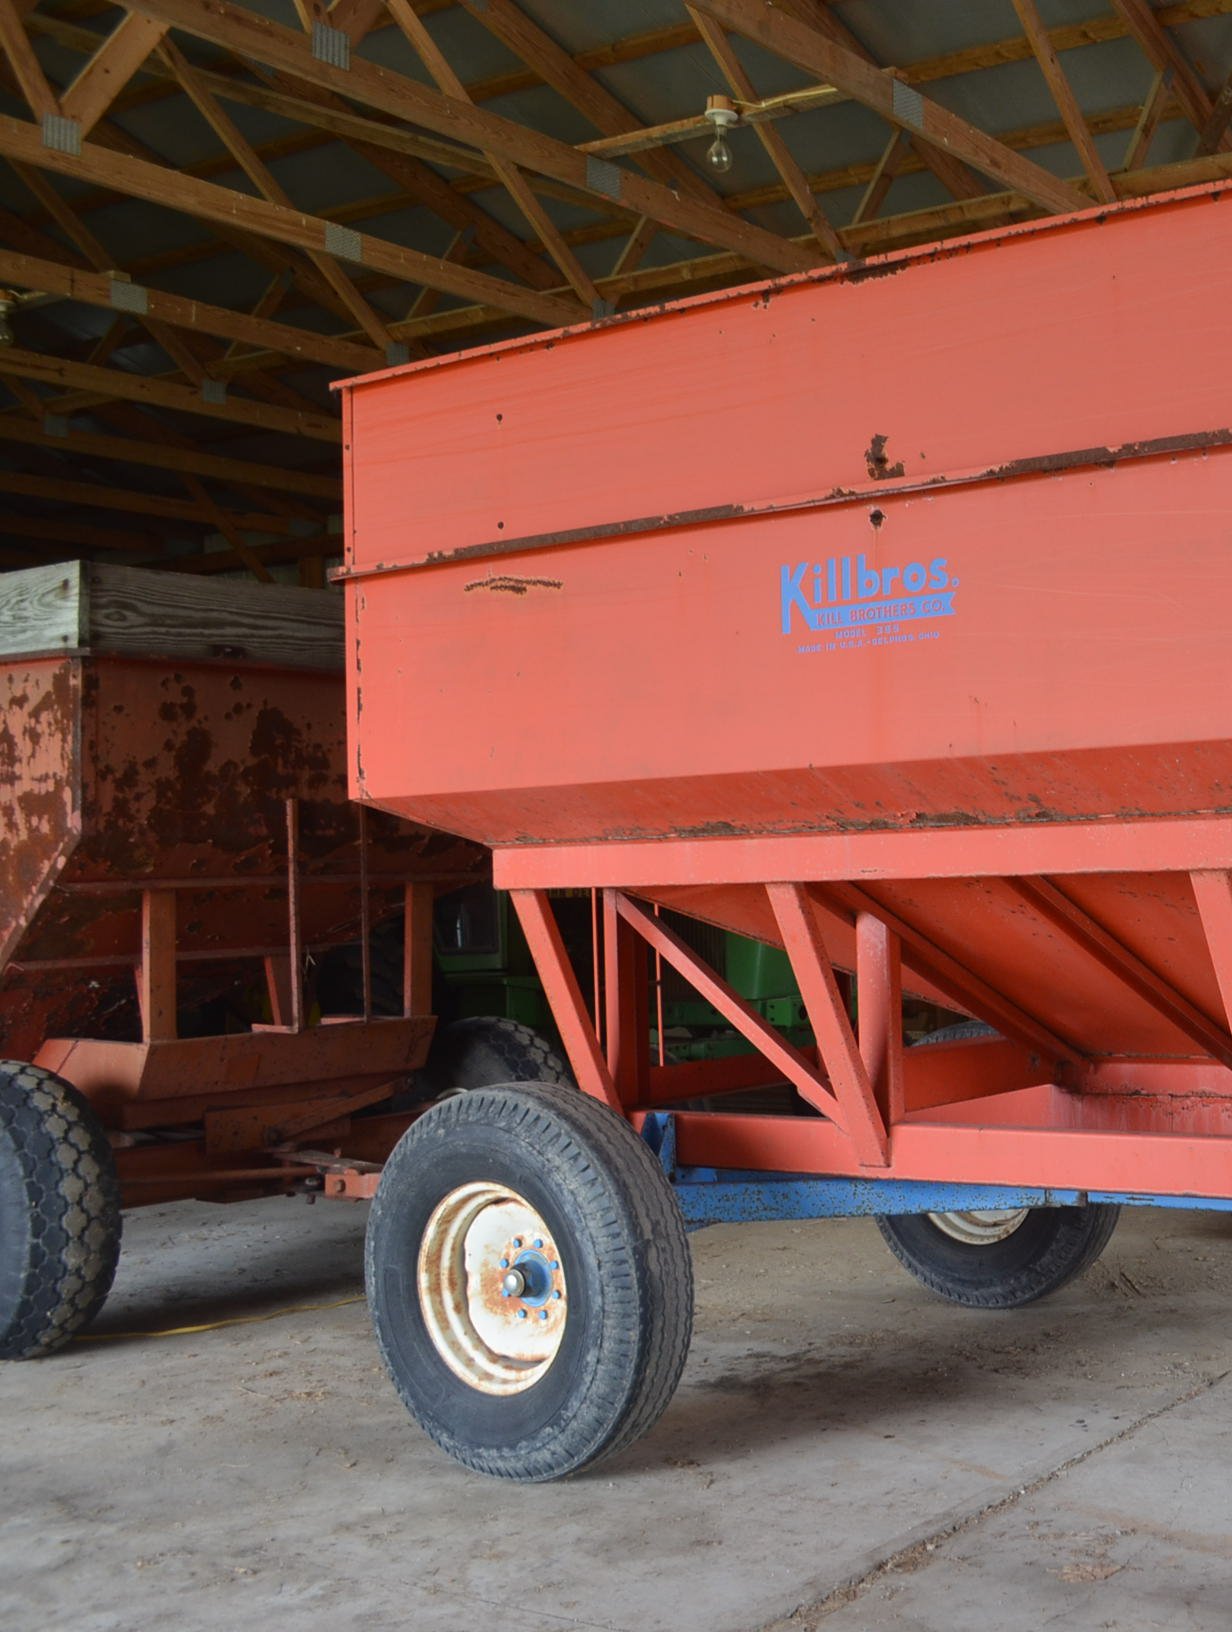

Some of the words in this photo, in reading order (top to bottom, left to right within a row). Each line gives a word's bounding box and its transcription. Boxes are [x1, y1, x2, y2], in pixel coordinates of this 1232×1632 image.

[816, 610, 845, 627] KILL
[849, 602, 917, 623] BROTHERS
[921, 598, 947, 614] CO.
